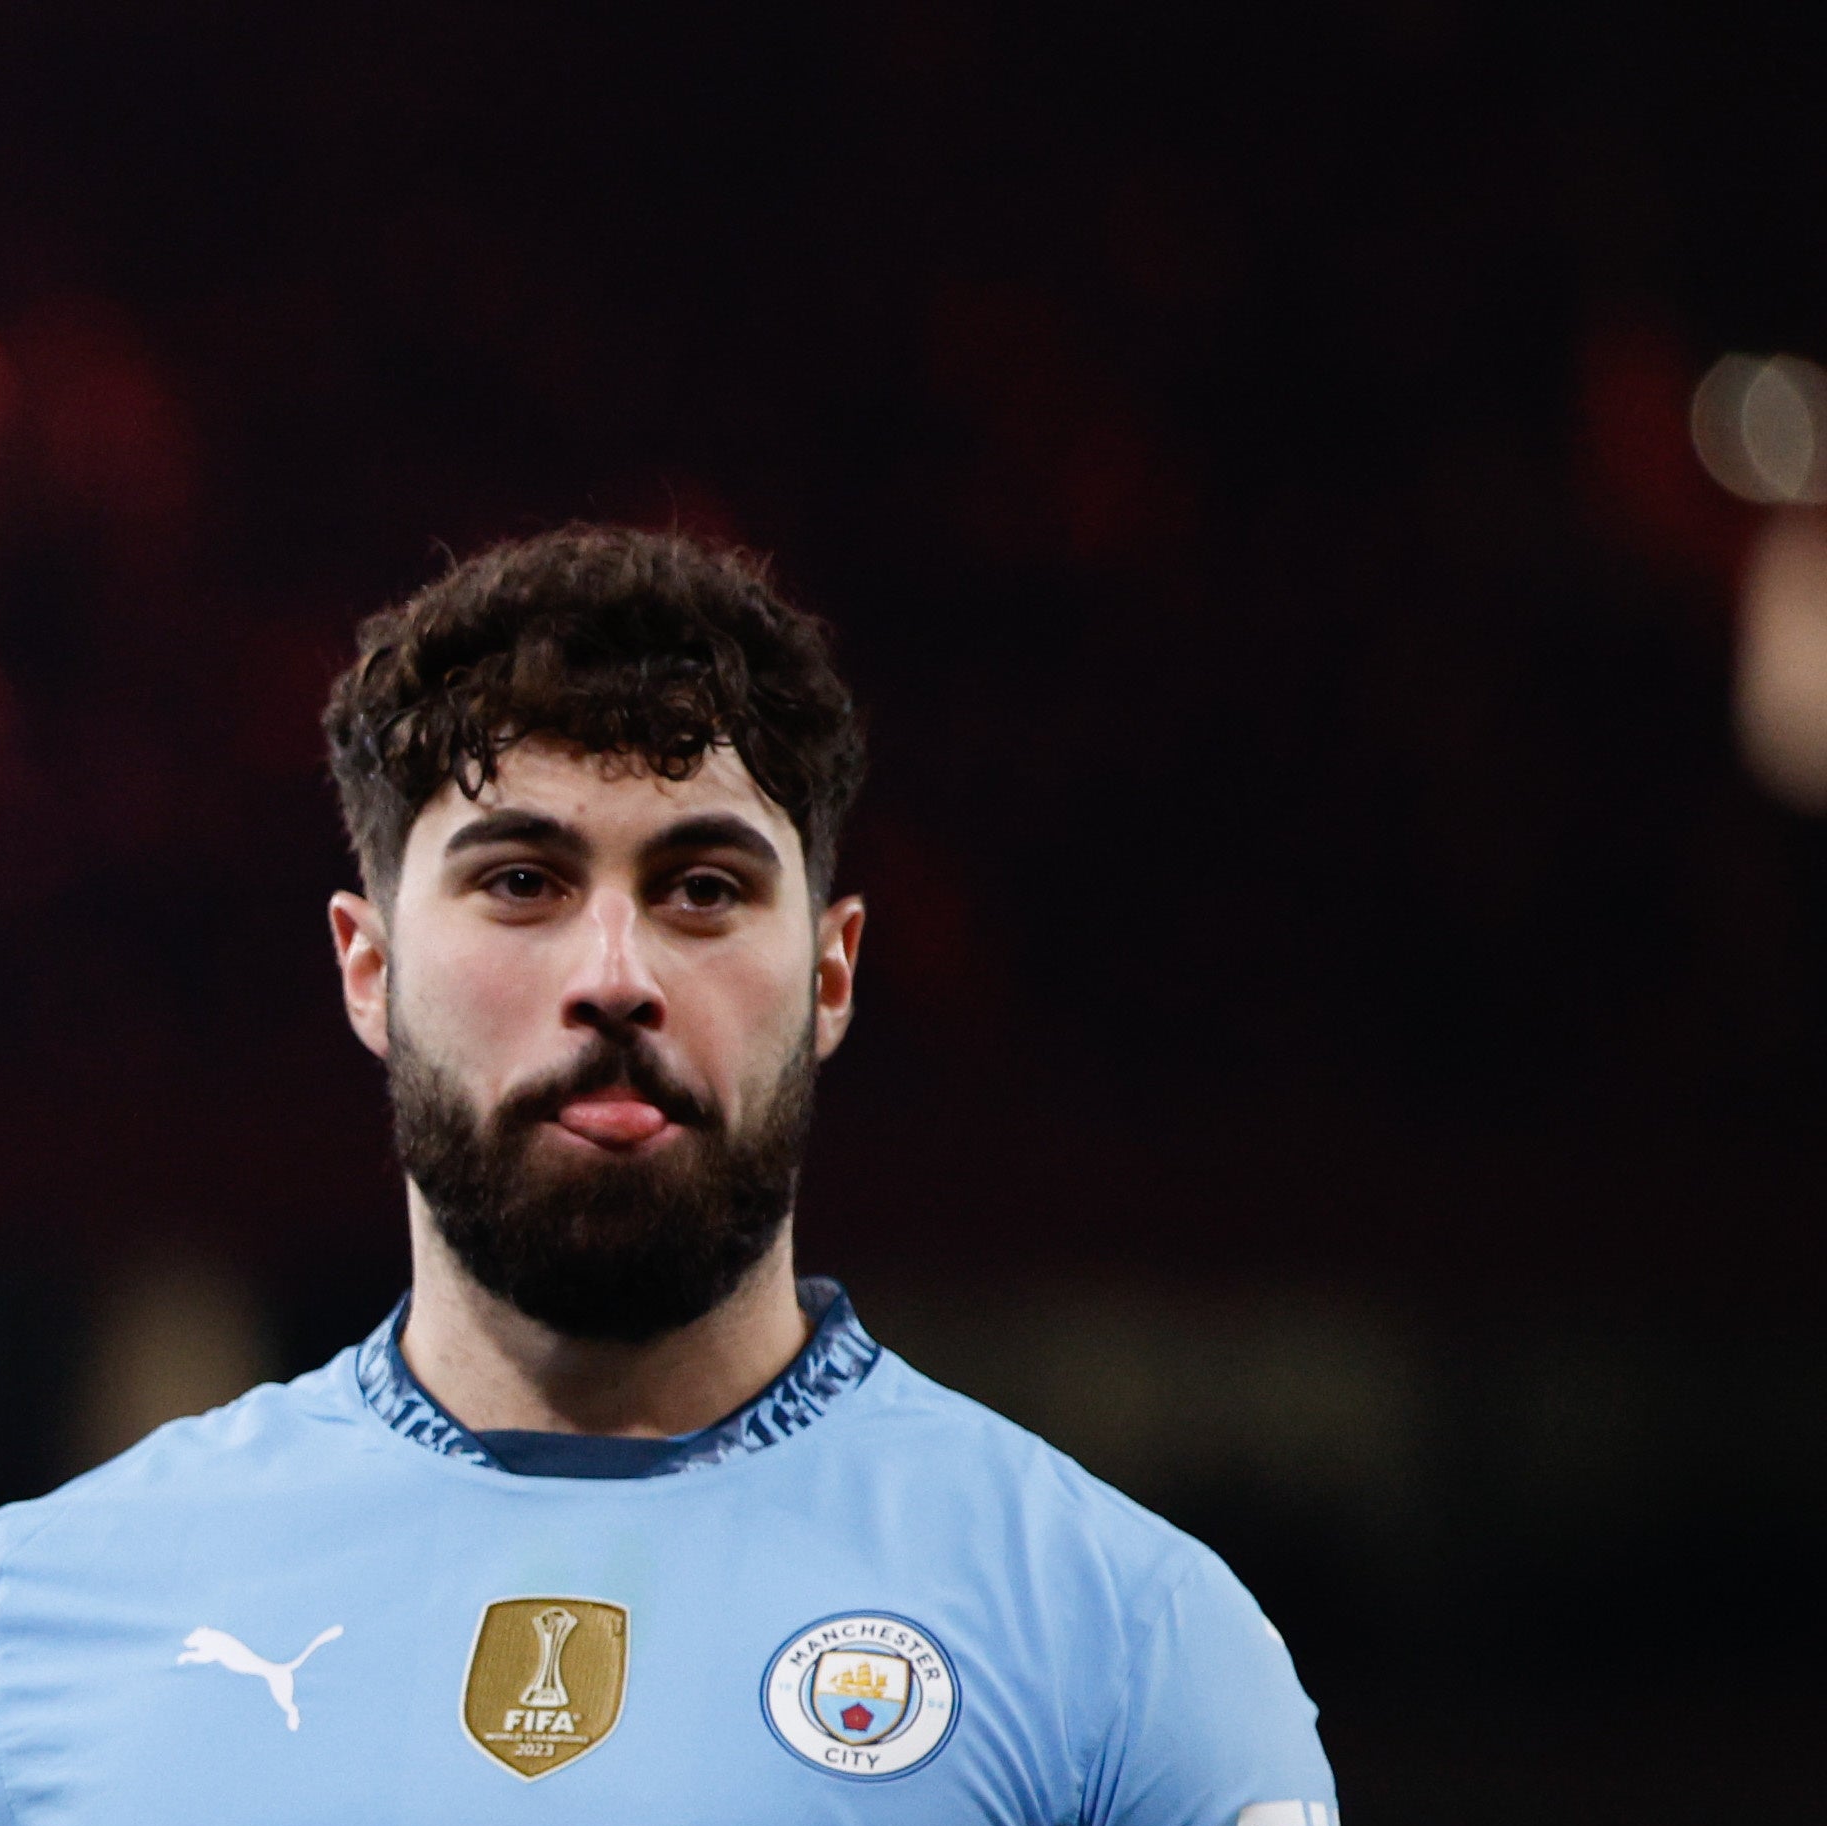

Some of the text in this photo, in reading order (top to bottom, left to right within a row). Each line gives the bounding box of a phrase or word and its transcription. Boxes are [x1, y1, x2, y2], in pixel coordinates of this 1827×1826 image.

[790, 1624, 941, 1682] MANCHESTER
[503, 1709, 576, 1733] FIFA
[825, 1747, 880, 1770] CITY
